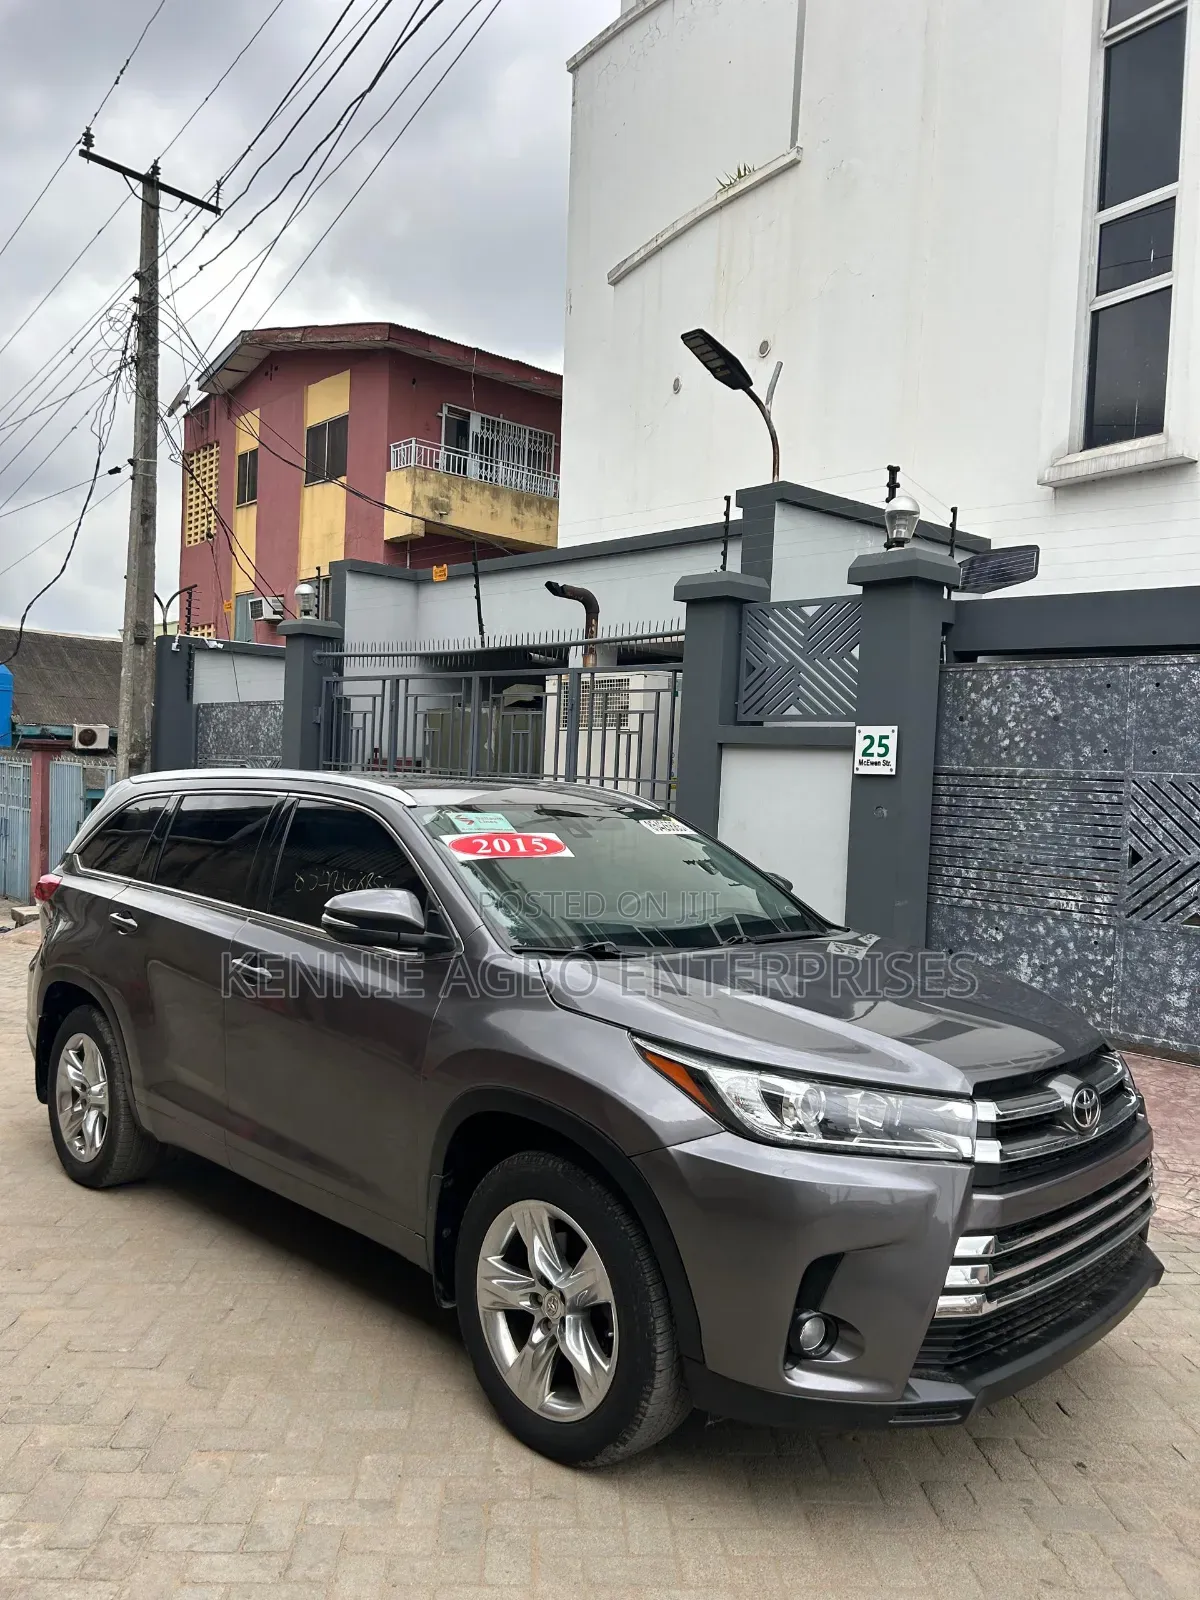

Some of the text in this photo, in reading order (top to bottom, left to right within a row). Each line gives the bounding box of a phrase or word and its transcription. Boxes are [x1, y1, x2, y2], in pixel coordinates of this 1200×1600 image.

[861, 734, 890, 758] 25
[858, 759, 881, 767] McEwen
[472, 837, 548, 854] 2015
